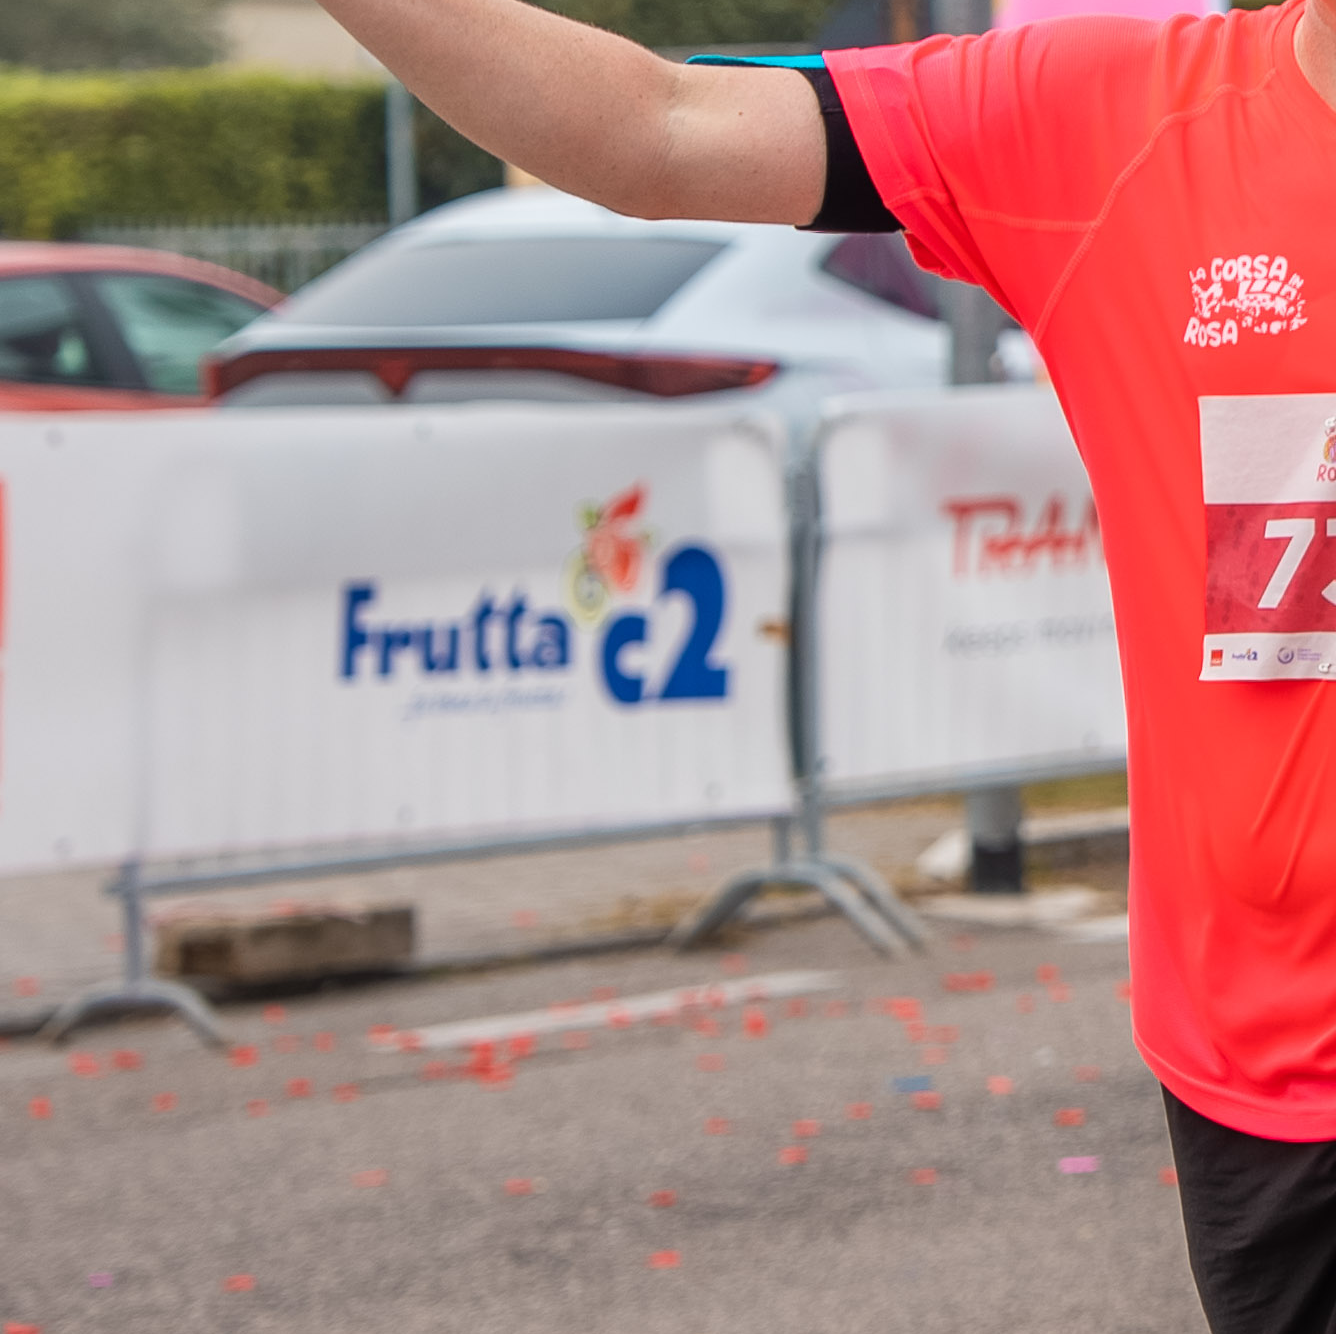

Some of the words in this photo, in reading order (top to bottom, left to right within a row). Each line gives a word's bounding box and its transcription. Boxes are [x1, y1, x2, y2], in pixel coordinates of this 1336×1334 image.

[1189, 266, 1206, 283] LA
[1210, 254, 1288, 282] CORSA
[1183, 316, 1238, 347] ROSA
[340, 583, 570, 679] Frutta
[601, 546, 729, 705] c2
